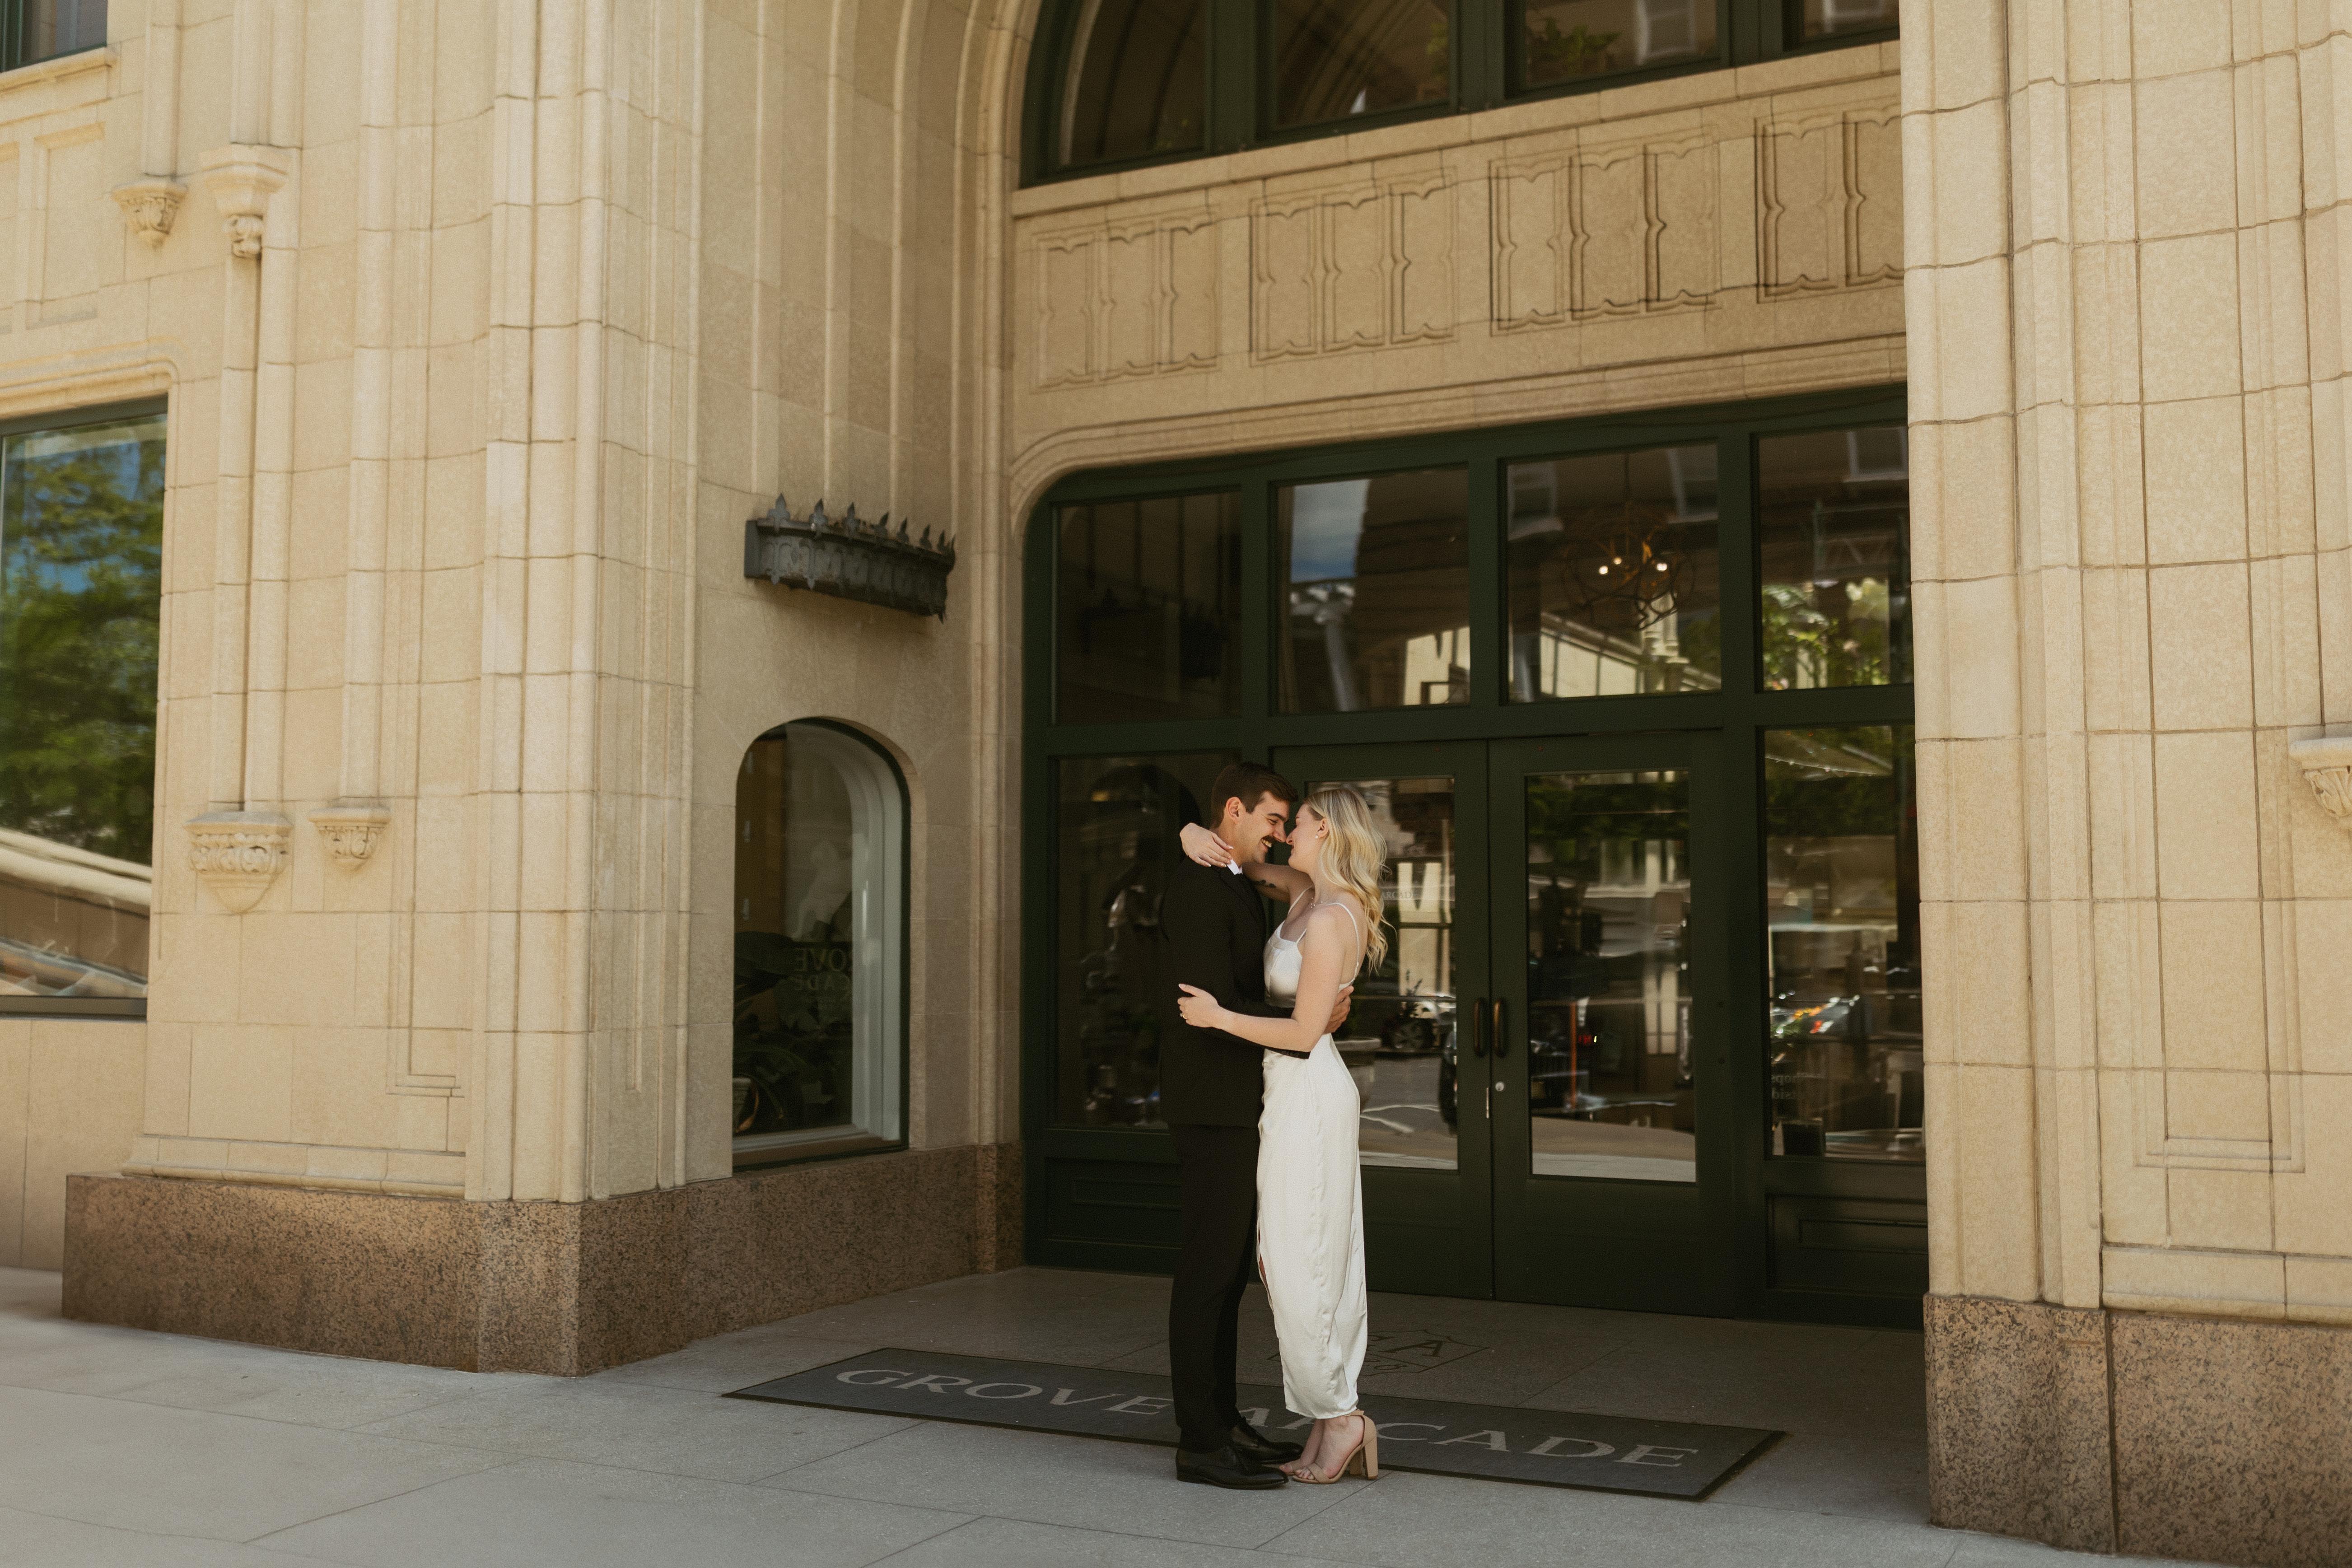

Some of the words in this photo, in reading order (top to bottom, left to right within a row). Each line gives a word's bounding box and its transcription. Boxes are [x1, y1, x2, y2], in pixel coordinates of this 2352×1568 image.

[1381, 891, 1418, 899] ARCAD
[836, 1369, 1174, 1415] GROVE
[1239, 1407, 1699, 1467] ACADE
